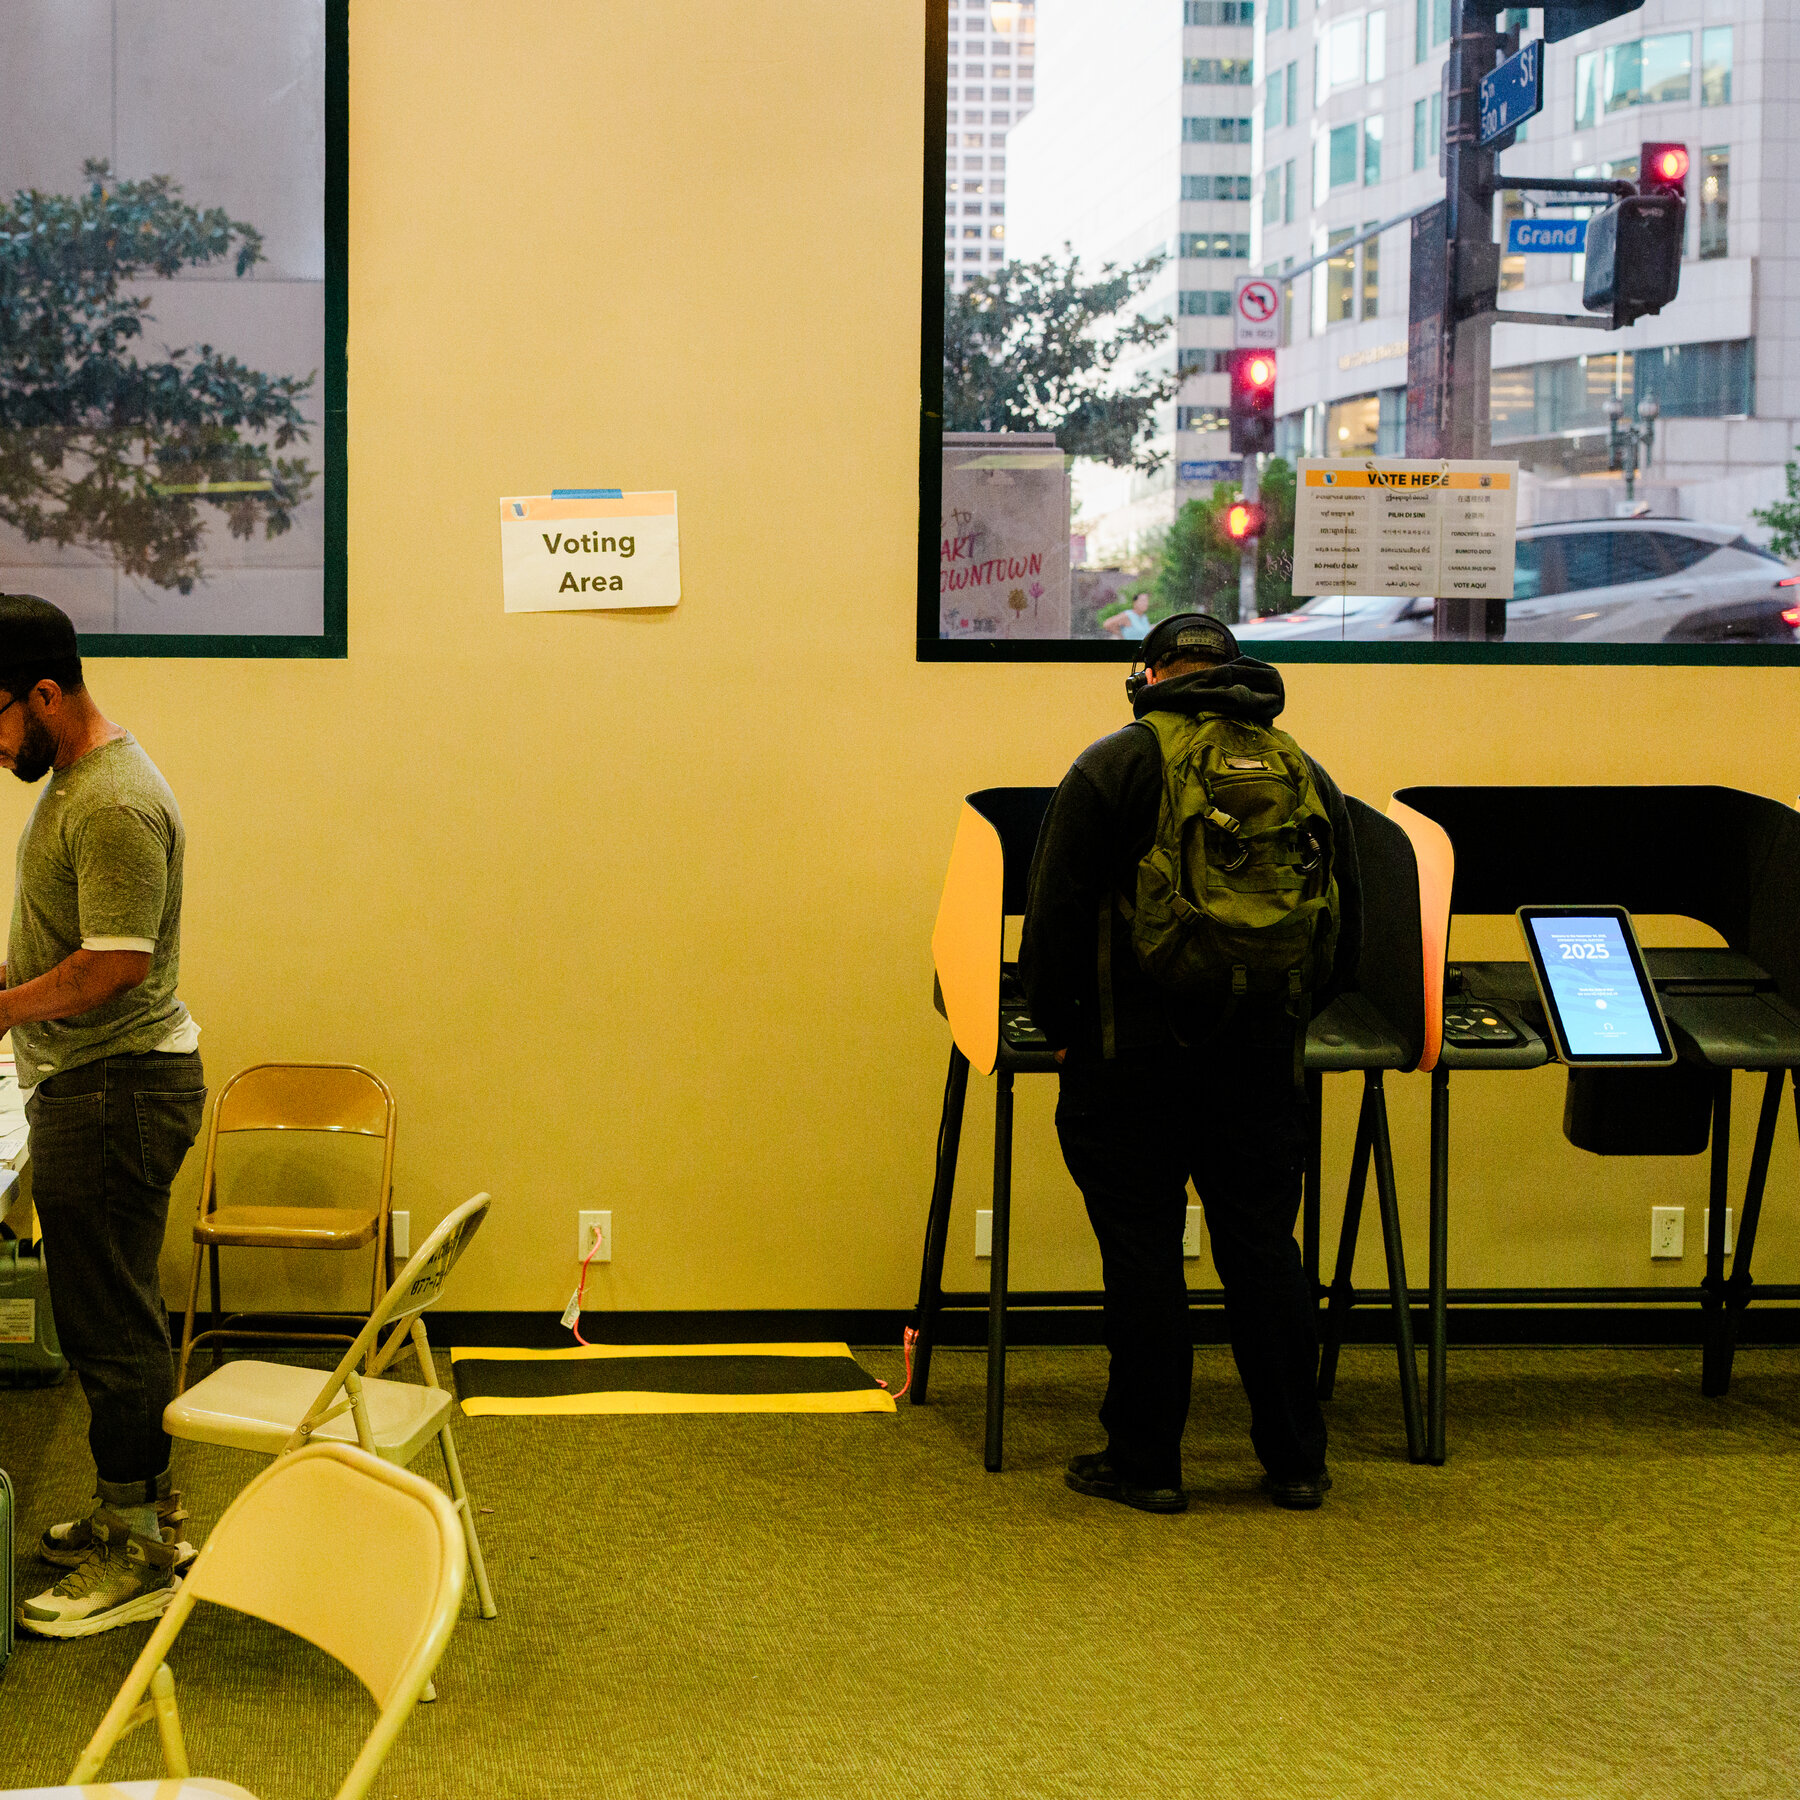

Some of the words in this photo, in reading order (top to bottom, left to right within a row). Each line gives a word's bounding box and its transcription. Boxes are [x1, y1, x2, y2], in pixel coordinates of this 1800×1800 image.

[1520, 48, 1534, 88] St
[1517, 225, 1578, 246] Grand
[1367, 474, 1407, 485] VOTE
[1411, 474, 1450, 487] HERE
[541, 530, 636, 559] Voting
[558, 571, 624, 594] Area
[1558, 943, 1610, 960] 2025
